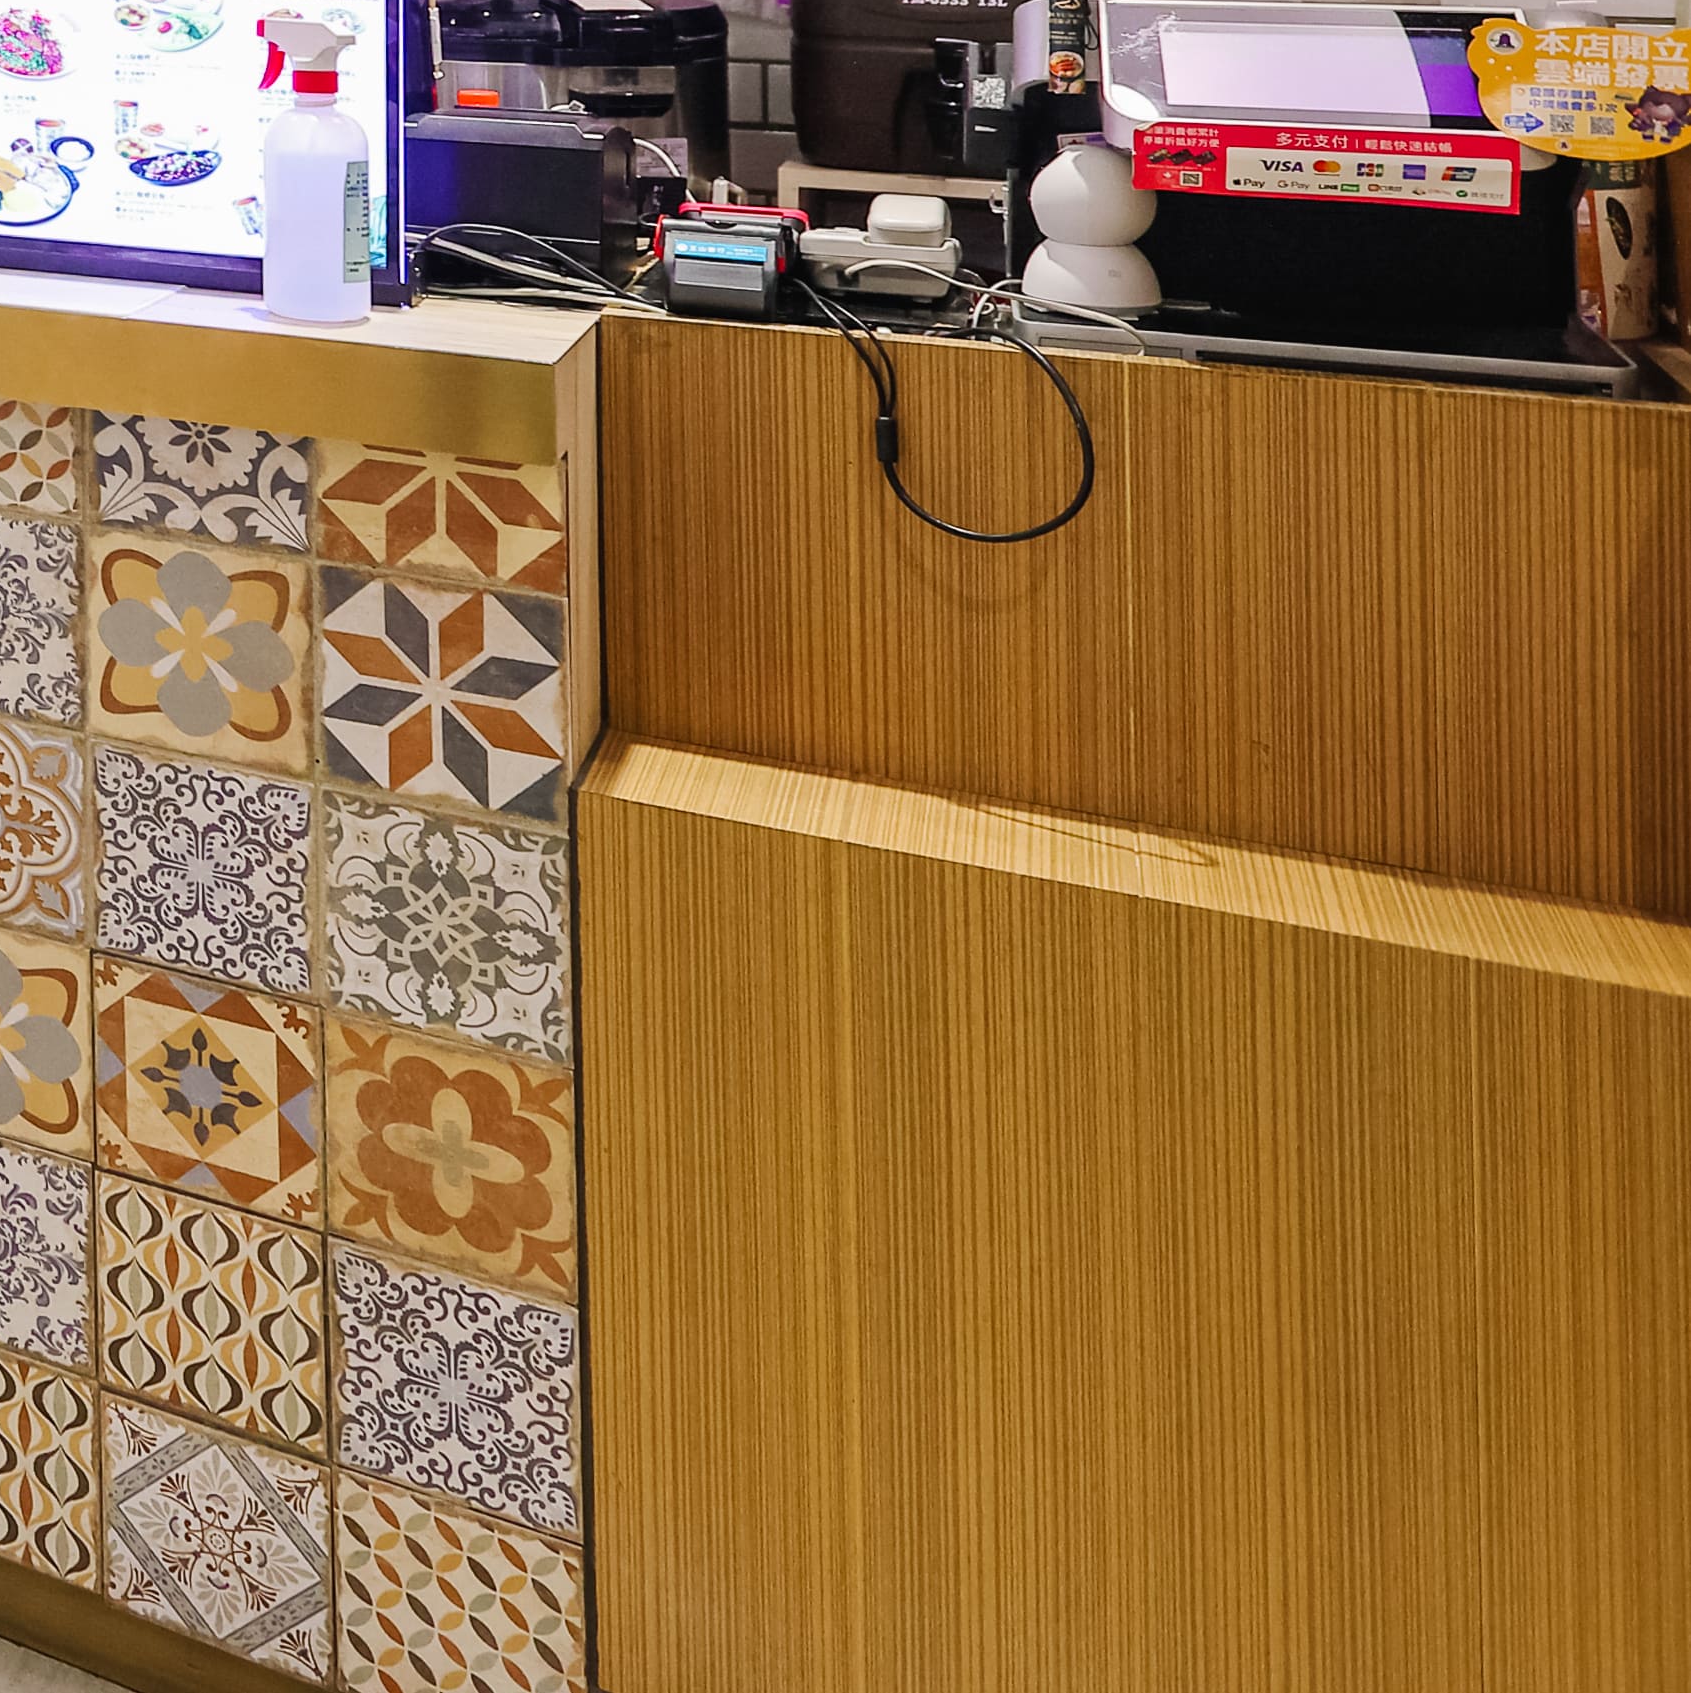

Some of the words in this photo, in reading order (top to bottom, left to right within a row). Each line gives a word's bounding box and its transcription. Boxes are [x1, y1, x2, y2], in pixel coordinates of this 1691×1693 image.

[1535, 30, 1689, 63] 本店開立
[1534, 58, 1690, 91] 雲端發票
[1276, 132, 1349, 149] 多元支付
[1260, 160, 1304, 172] VISA
[1243, 179, 1266, 189] Pay
[1291, 181, 1310, 190] Pay
